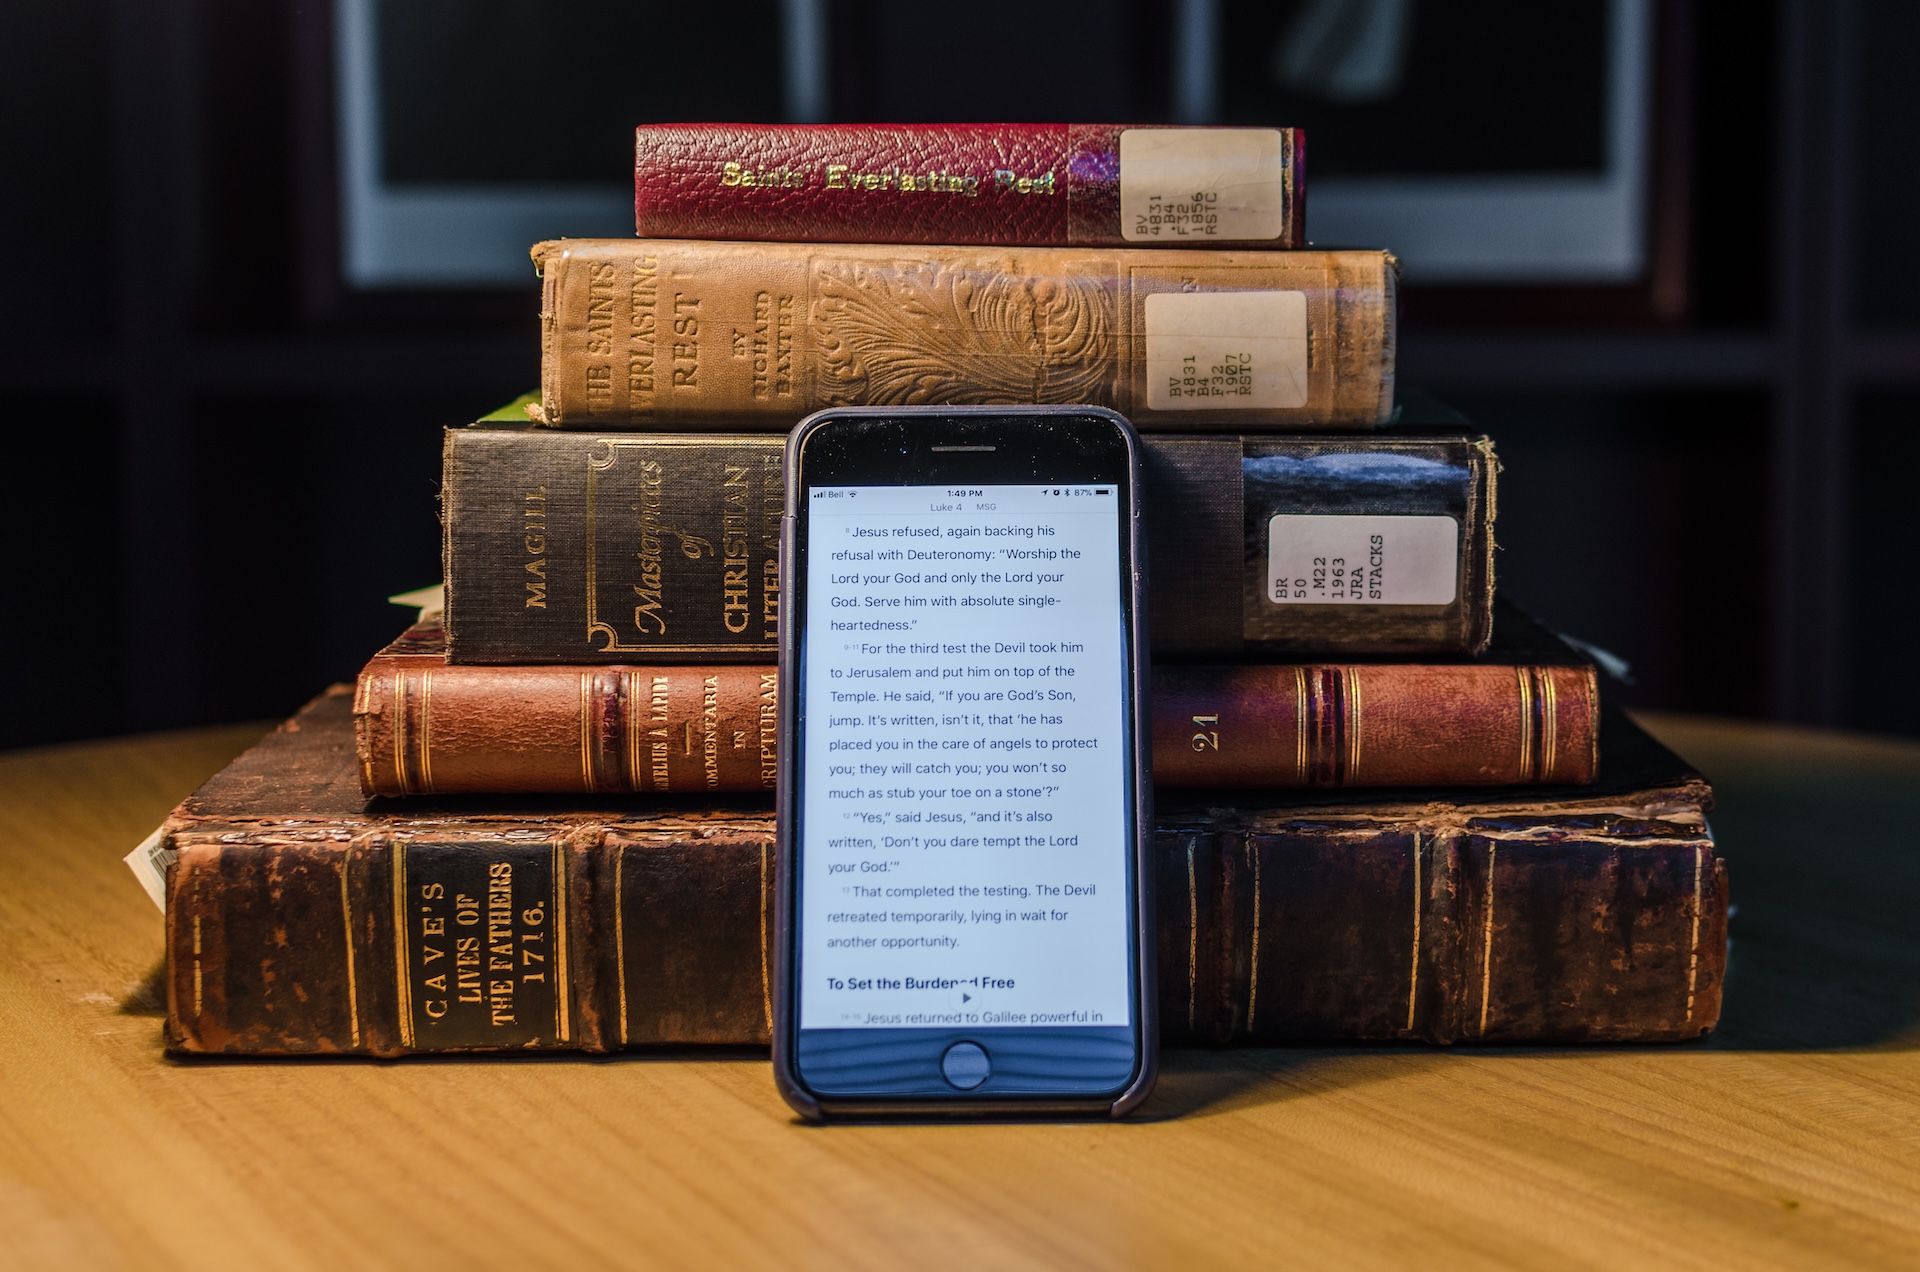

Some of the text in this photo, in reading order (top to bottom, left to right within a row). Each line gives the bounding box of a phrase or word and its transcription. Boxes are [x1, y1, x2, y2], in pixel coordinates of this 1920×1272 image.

[826, 164, 979, 197] Everlasting
[995, 169, 1056, 196] Rest
[1136, 215, 1148, 235] BV
[1150, 195, 1162, 235] 4831
[1164, 204, 1176, 231] .B4
[1177, 204, 1189, 235] F32
[1191, 192, 1204, 232] 1856
[1205, 192, 1217, 235] RSTC
[673, 292, 701, 387] REST
[732, 328, 747, 359] BY
[754, 290, 770, 400] RICHARD
[776, 293, 794, 397] BAXTER
[587, 364, 611, 416] THE
[1170, 377, 1182, 397] BV
[1183, 355, 1196, 397] 4831
[1197, 377, 1209, 397] B4
[1212, 365, 1224, 396] F32
[1226, 354, 1238, 395] 1907
[1239, 353, 1252, 396] RSTC
[828, 491, 844, 499] Bell
[930, 503, 962, 512] Luke 4
[976, 503, 997, 511] MSG
[525, 485, 547, 609] MAGILL
[631, 459, 677, 635] Masterpieces
[675, 529, 715, 559] of
[852, 527, 889, 537] Jesus
[892, 526, 943, 538] refused,
[947, 525, 981, 539] again
[985, 525, 1033, 539] backing
[1037, 525, 1055, 536] his
[722, 463, 750, 633] CHRISTIAN
[832, 549, 873, 561] refusal
[877, 549, 903, 560] with
[908, 549, 995, 562] Deuteronomy:
[1060, 548, 1081, 559] the
[831, 571, 1065, 586] Lord your God and only the Lord your
[1314, 557, 1326, 596] .M22
[1332, 558, 1345, 598] 1963
[1370, 534, 1383, 599] STACKS
[1275, 577, 1288, 599] BR
[1294, 578, 1307, 598] 50
[1351, 567, 1363, 599] JRA
[831, 594, 1061, 608] God. Serve him with absolute single-
[862, 641, 1084, 654] For the third test the Devil took him
[830, 665, 1075, 679] to Jerusalem and put him on top of the
[830, 691, 879, 704] Temple.
[884, 691, 901, 702] He
[905, 690, 934, 703] said,
[957, 692, 980, 704] you
[984, 692, 1004, 701] are
[1048, 689, 1076, 702] Son,
[829, 715, 864, 728] jump.
[890, 714, 938, 727] written,
[973, 714, 984, 727] it,
[988, 714, 1013, 725] that
[1040, 713, 1063, 725] has
[1192, 714, 1218, 752] 21
[734, 730, 746, 749] IN
[829, 738, 1098, 752] placed you in the care of angels to protect
[829, 766, 855, 777] you;
[860, 763, 888, 776] they
[891, 763, 911, 774] will
[915, 762, 951, 774] catch
[955, 765, 981, 776] you;
[985, 764, 1009, 776] you
[1051, 764, 1067, 773] so
[829, 788, 864, 799] much
[868, 790, 883, 798] as
[887, 787, 915, 798] stub
[919, 789, 947, 801] your
[951, 788, 972, 798] toe
[975, 789, 991, 798] on
[995, 789, 1002, 798] a
[895, 811, 921, 823] said
[925, 812, 966, 824] Jesus,
[1026, 810, 1053, 822] also
[828, 864, 857, 875] your
[422, 882, 448, 1018] CAVE'S
[456, 893, 482, 1004] LIVES OF
[489, 862, 515, 1026] THE FATHERS
[522, 900, 545, 984] 1716.
[827, 976, 1015, 990] To Set the Burdend Free
